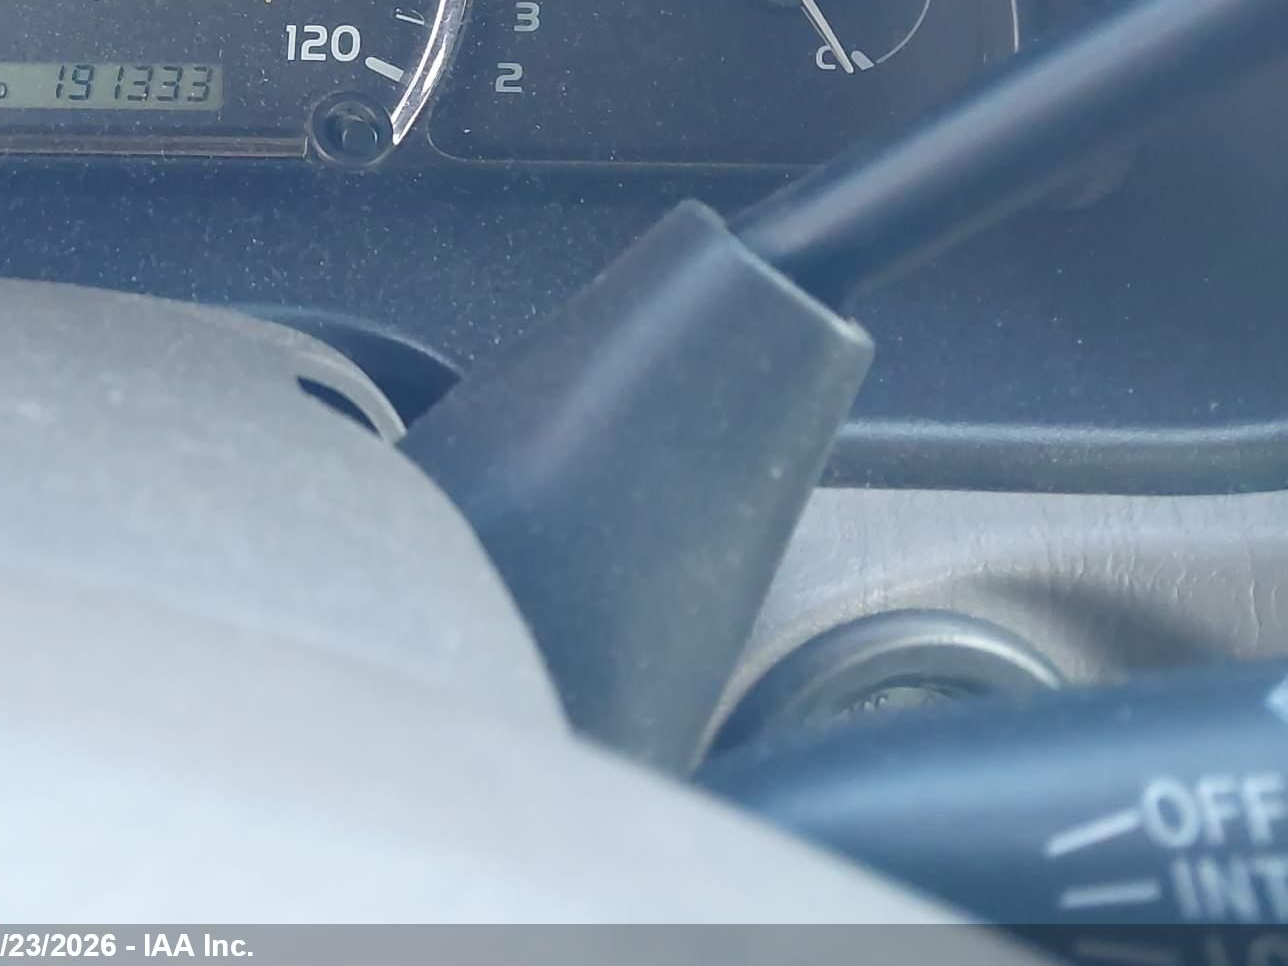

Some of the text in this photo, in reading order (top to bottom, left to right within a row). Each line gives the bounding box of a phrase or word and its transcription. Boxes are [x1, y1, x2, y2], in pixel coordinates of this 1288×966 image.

[513, 1, 540, 32] 3
[286, 24, 361, 62] 120
[816, 45, 836, 69] C
[55, 65, 213, 102] 191333
[495, 62, 523, 93] 2
[1144, 777, 1285, 848] OFF
